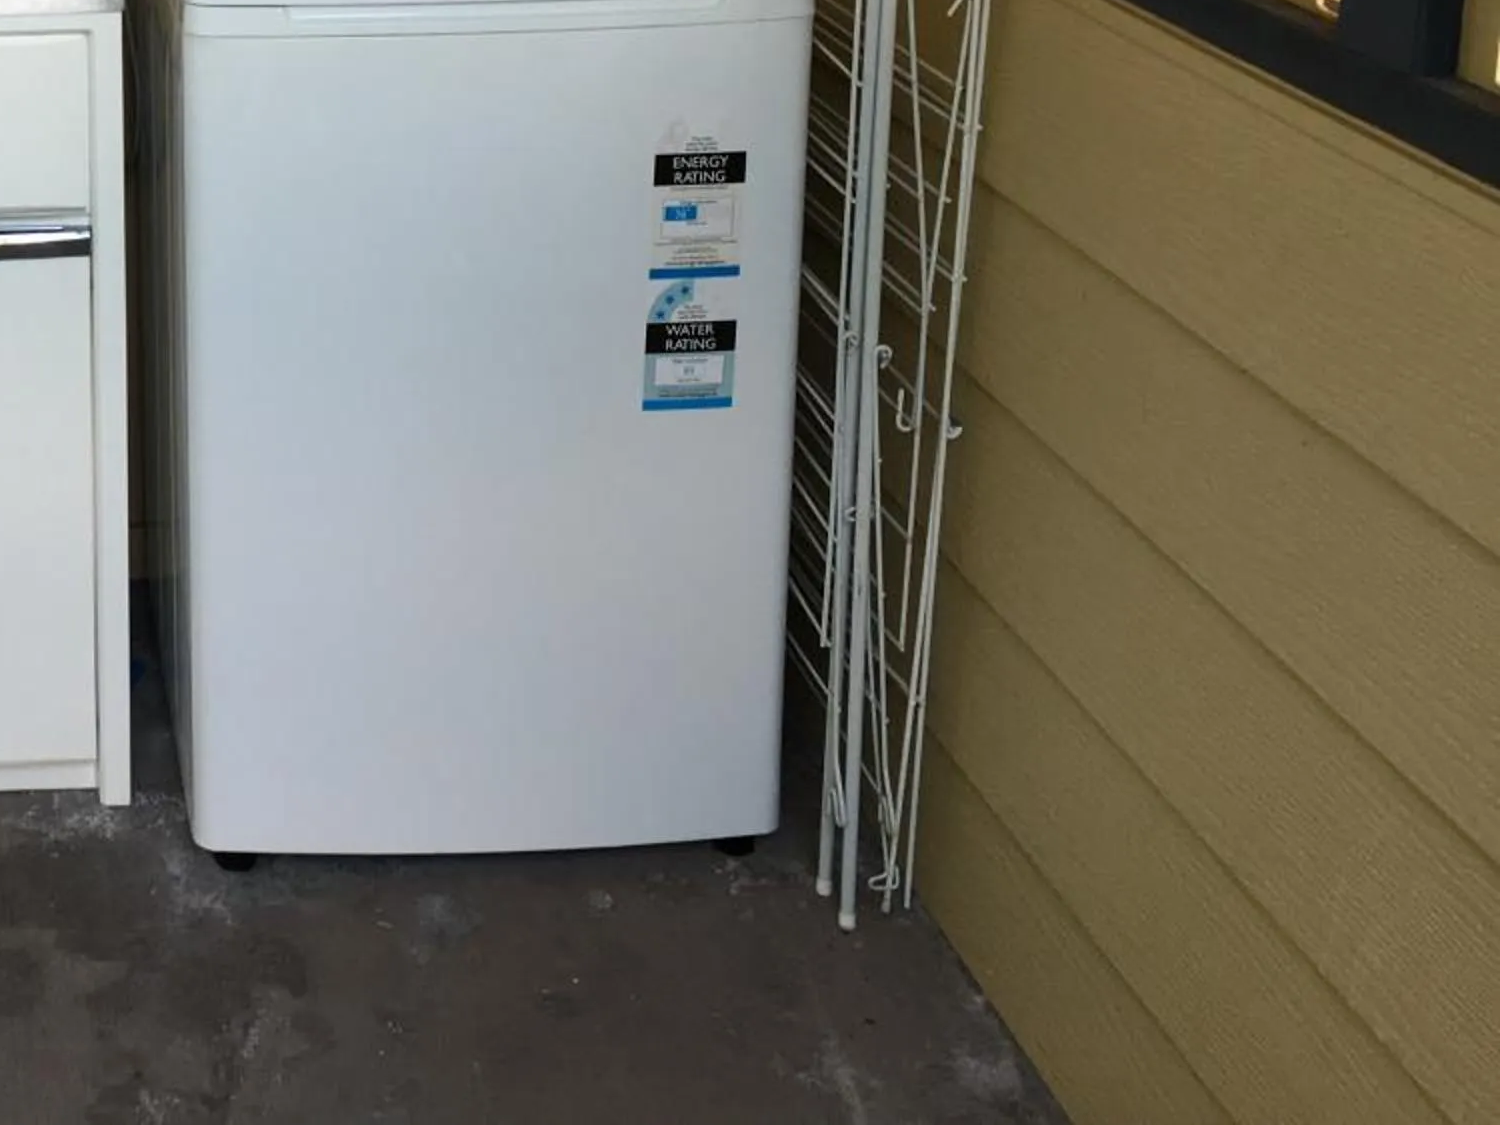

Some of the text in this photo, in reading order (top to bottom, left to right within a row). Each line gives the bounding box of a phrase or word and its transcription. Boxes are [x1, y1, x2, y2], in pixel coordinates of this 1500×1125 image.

[673, 154, 729, 169] ENERGY
[673, 170, 725, 184] RATING
[665, 322, 714, 336] WATER
[665, 337, 717, 351] RATING
